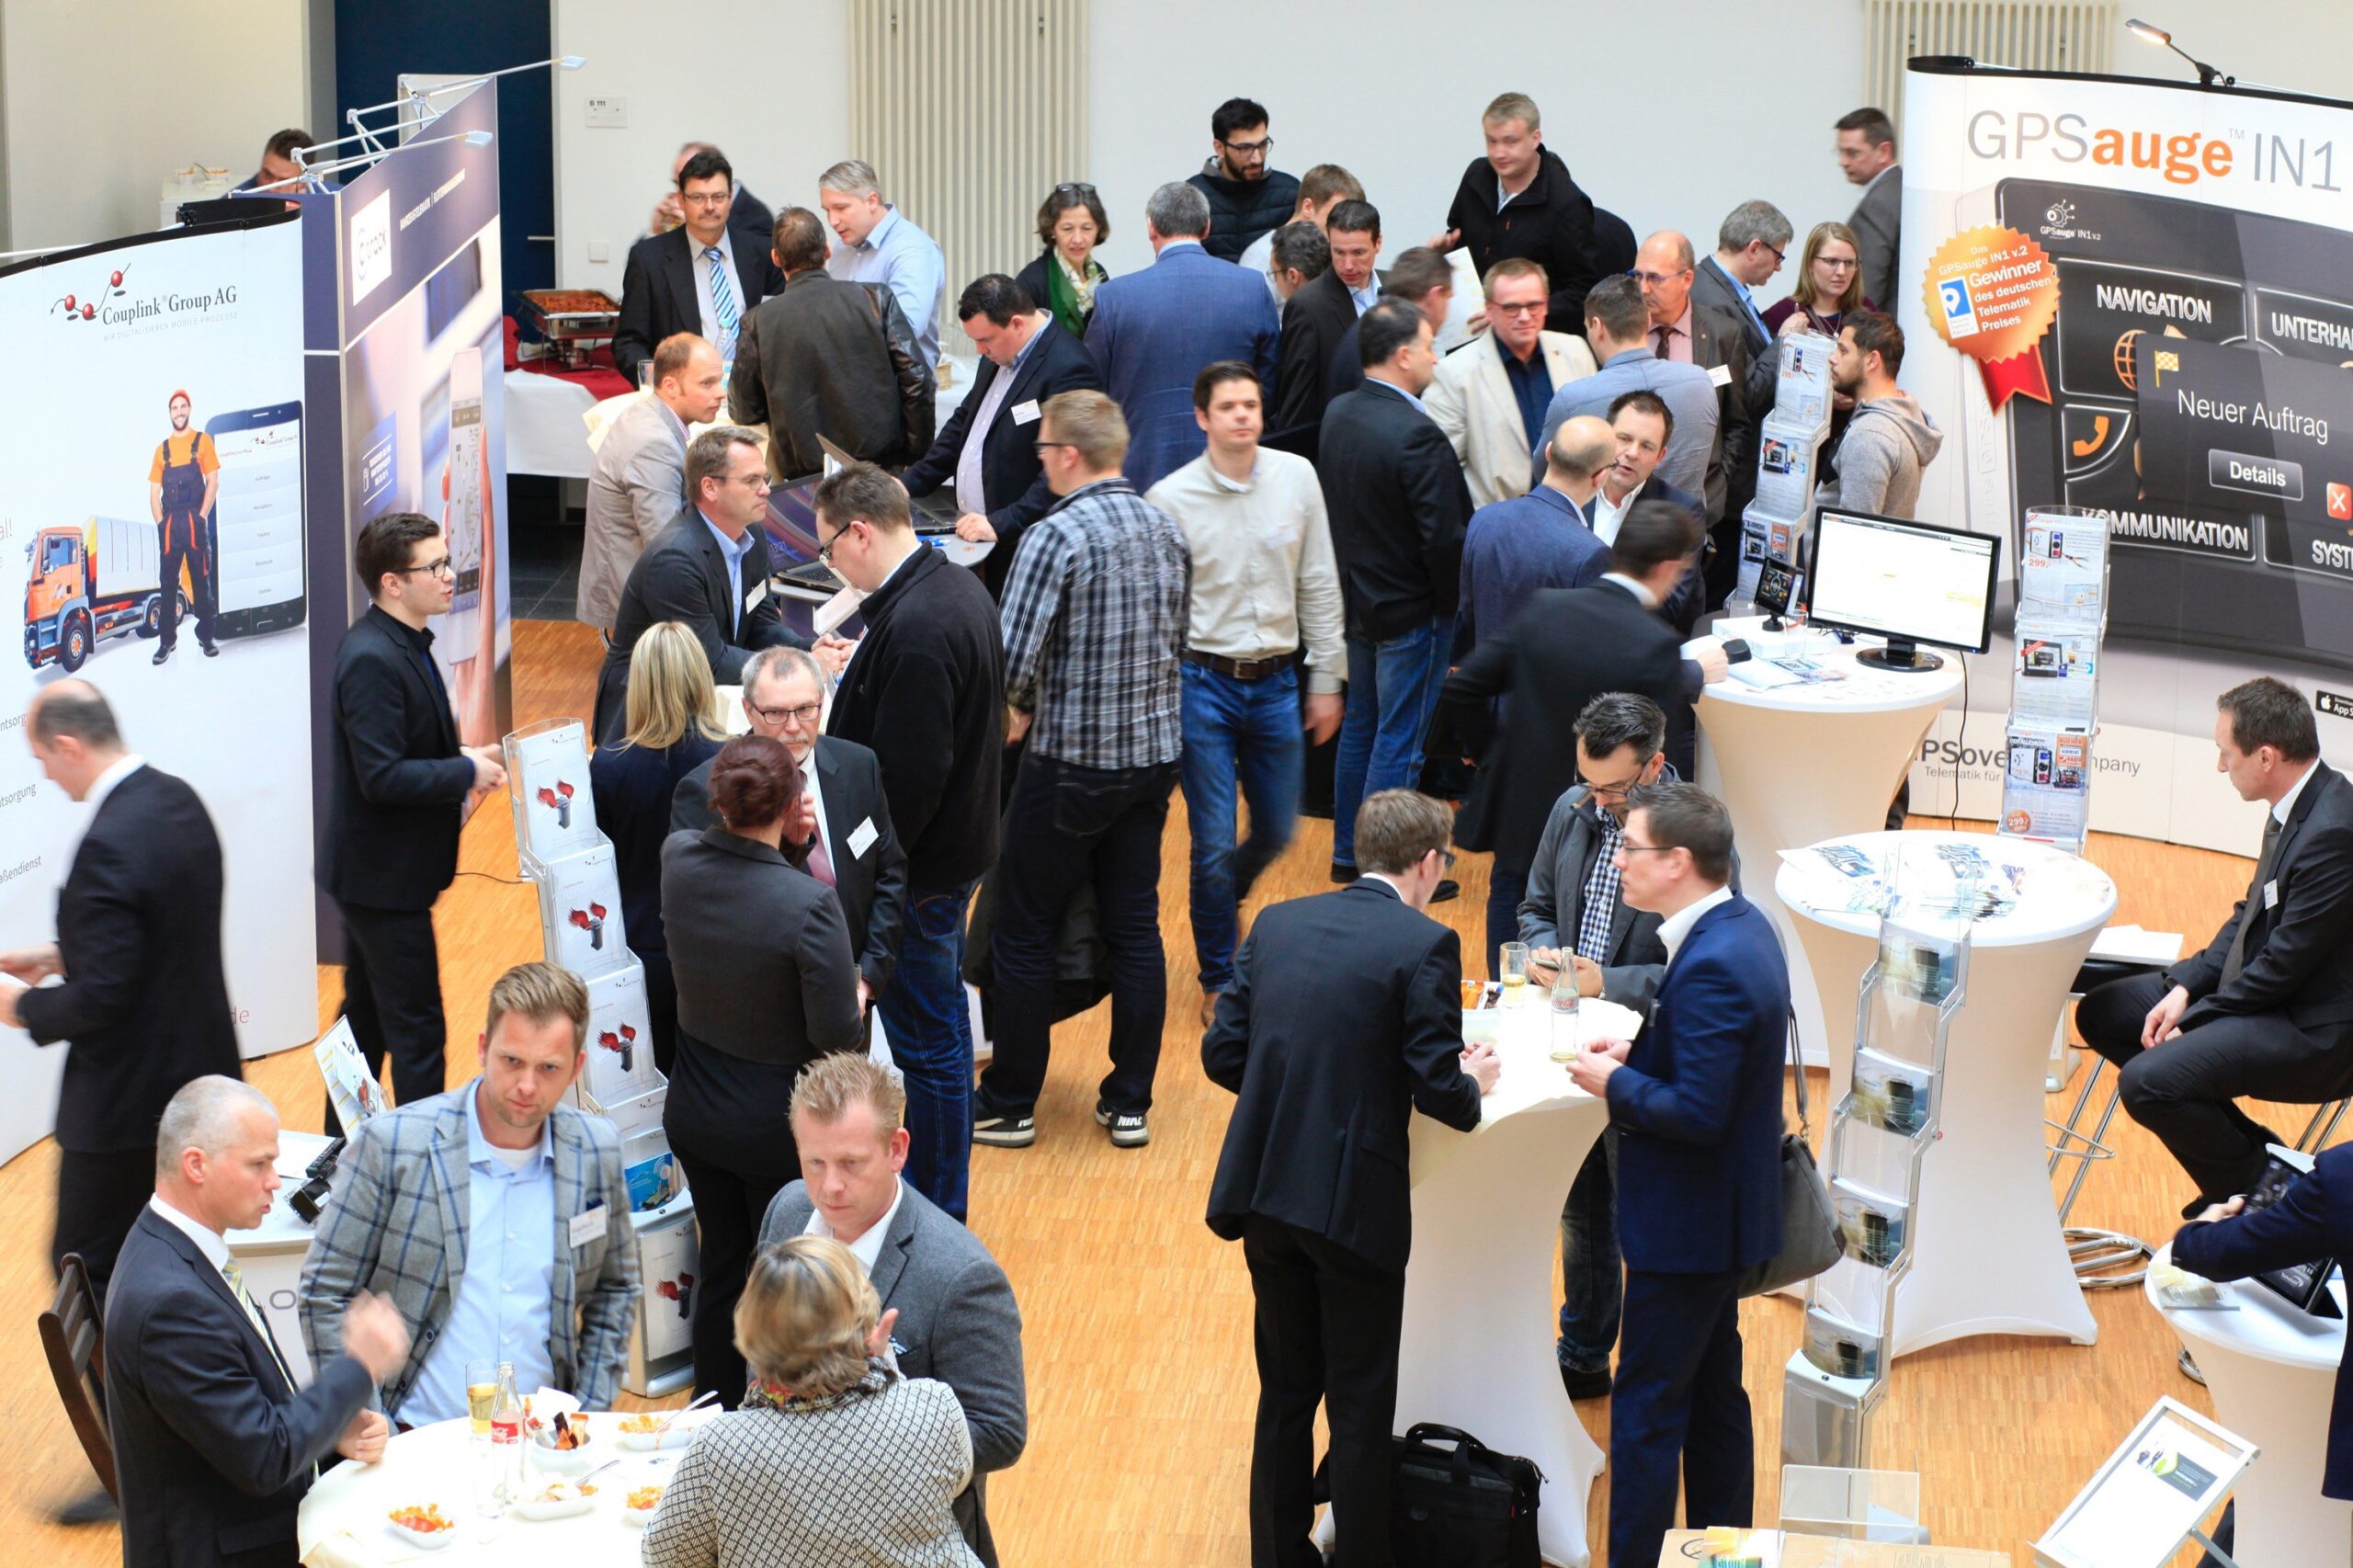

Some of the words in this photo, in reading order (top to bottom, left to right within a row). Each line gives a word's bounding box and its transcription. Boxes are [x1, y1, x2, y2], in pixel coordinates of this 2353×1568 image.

[1967, 109, 2234, 185] GPSauge
[2253, 132, 2342, 192] IN1
[2040, 226, 2075, 239] GPSauge
[1938, 256, 1989, 276] GPSauge
[1990, 249, 2010, 264] IN1
[2011, 244, 2029, 258] v.2
[1970, 244, 1988, 256] Das
[1969, 259, 2042, 288] Gewinner
[168, 293, 212, 312] Group
[214, 285, 237, 305] AG
[1974, 290, 1995, 303] des
[1995, 277, 2052, 298] deutschen
[2097, 283, 2211, 324] NAVIGATION
[1976, 296, 2031, 318] Telematik
[1981, 314, 2022, 333] Preises
[2271, 312, 2353, 352] UNTERHA
[2177, 388, 2247, 425] Neuer
[2252, 402, 2328, 446] Auftrag
[2229, 460, 2287, 487] Details
[2312, 539, 2353, 571] SYST
[2333, 703, 2349, 716] App
[1926, 766, 1981, 780] Telematik
[1984, 769, 2001, 782] für
